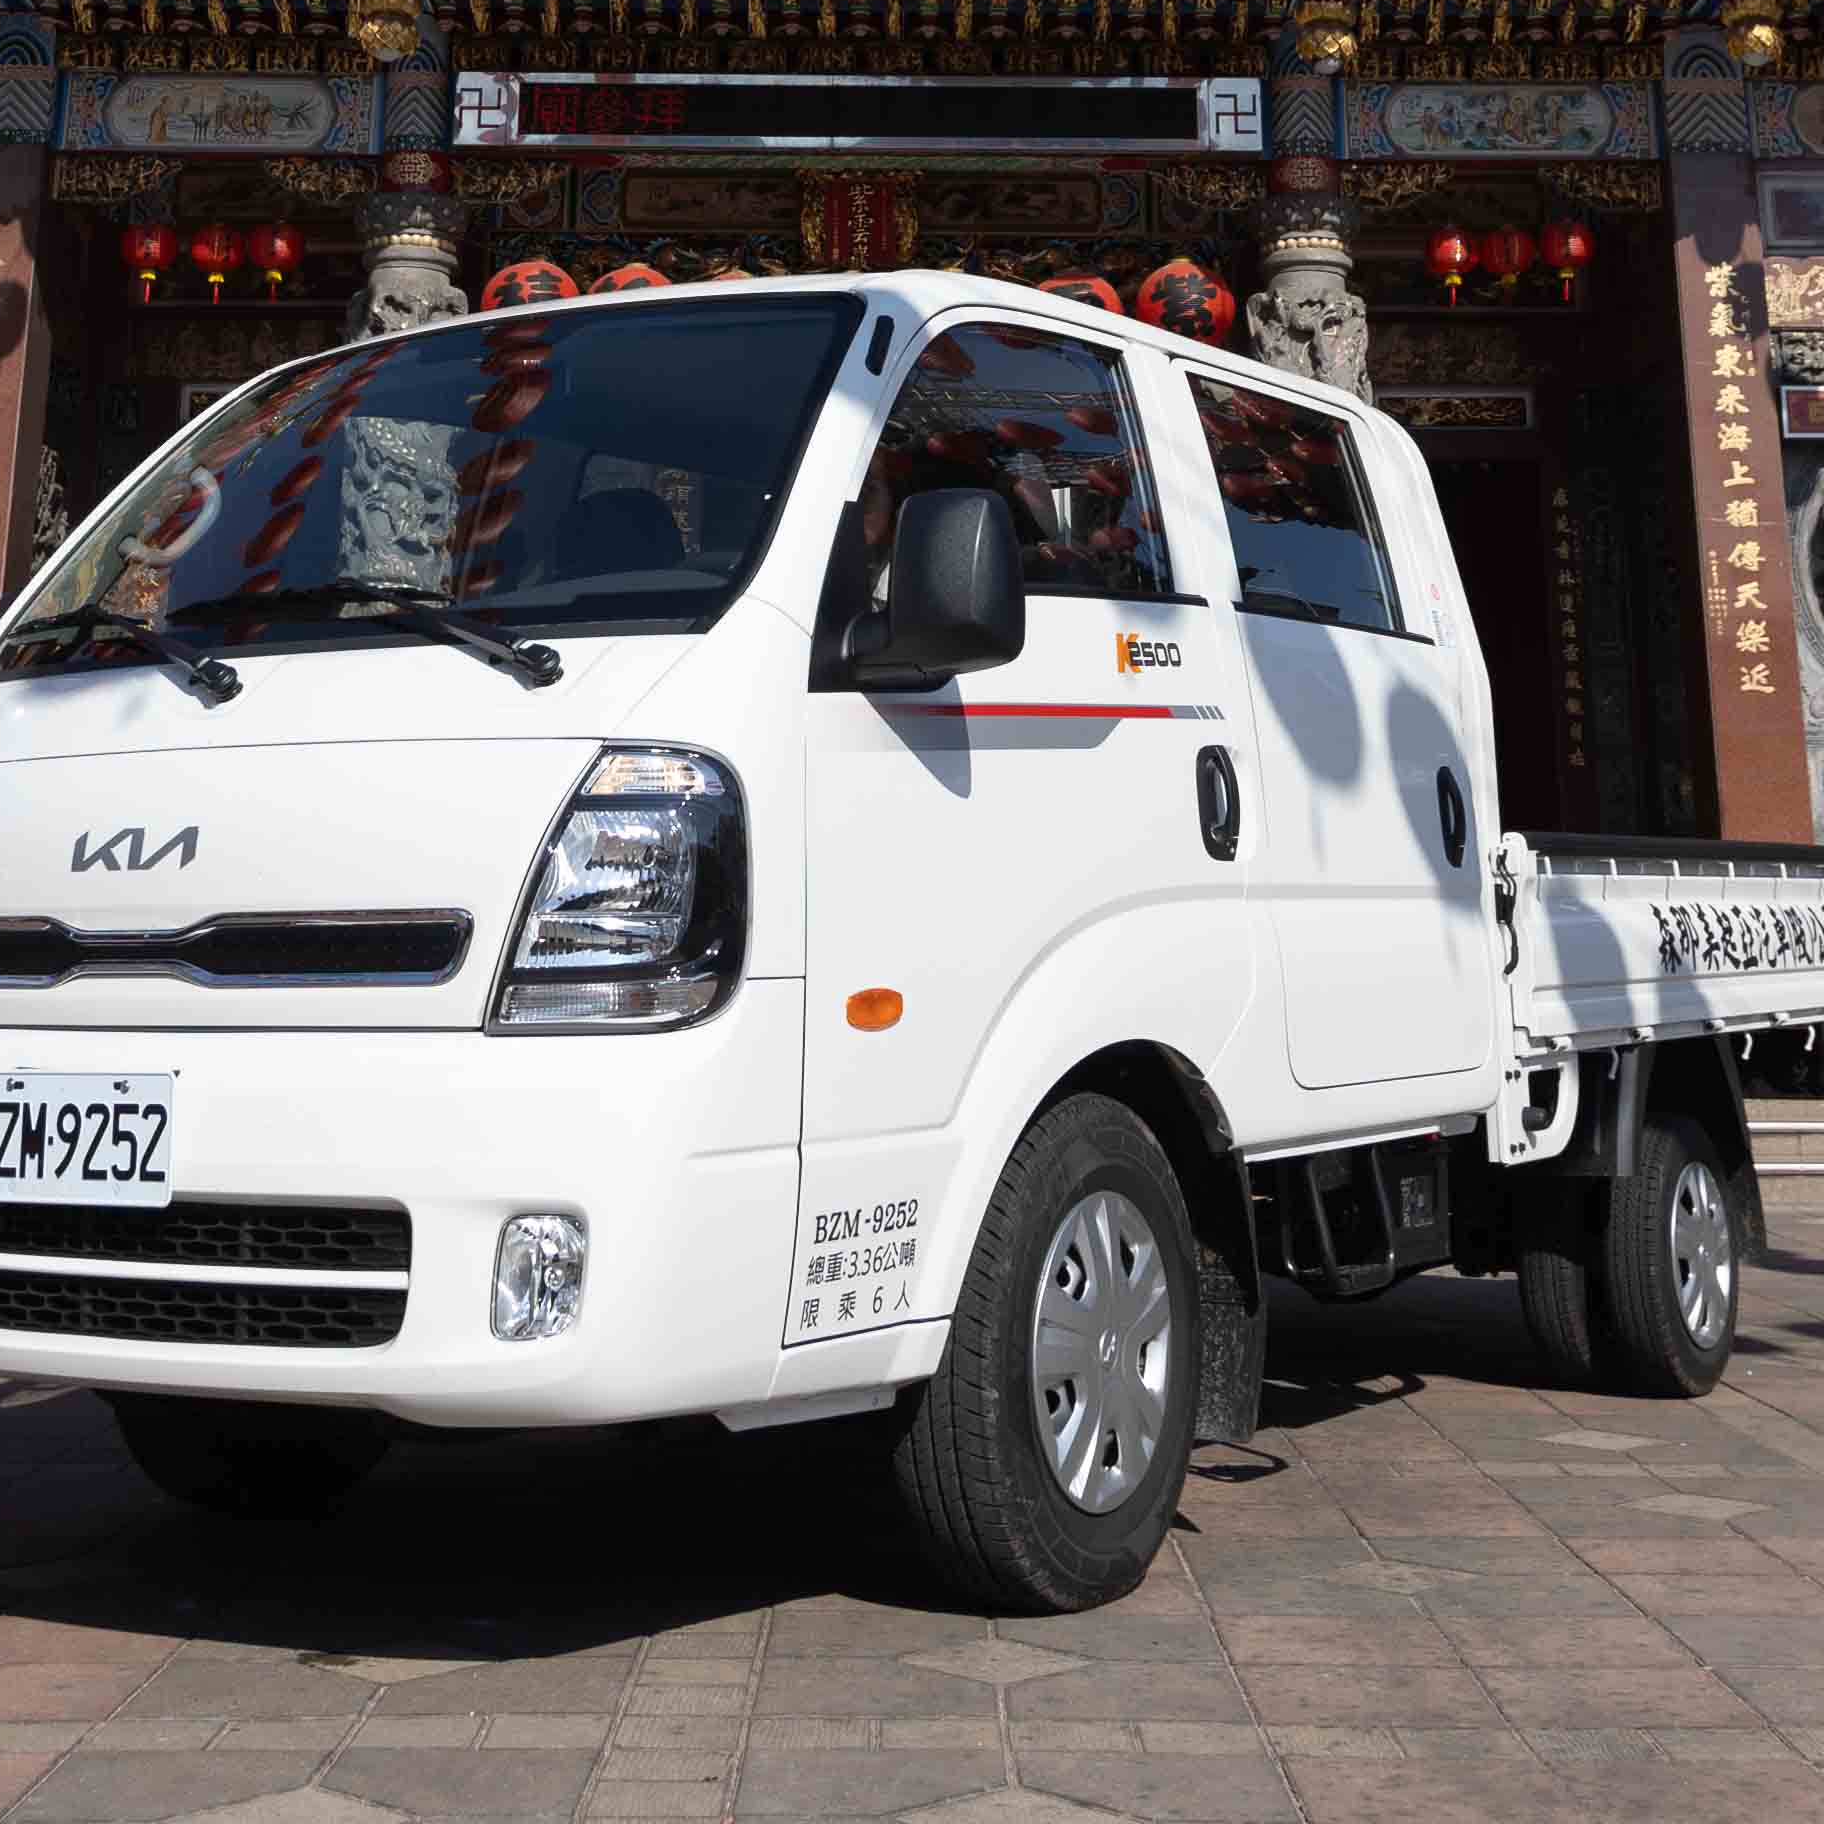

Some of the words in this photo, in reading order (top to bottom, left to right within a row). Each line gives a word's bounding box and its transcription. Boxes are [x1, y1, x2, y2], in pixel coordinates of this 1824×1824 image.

[1151, 271, 1218, 337] 紫
[1115, 632, 1182, 673] K2500
[71, 825, 198, 873] KIA
